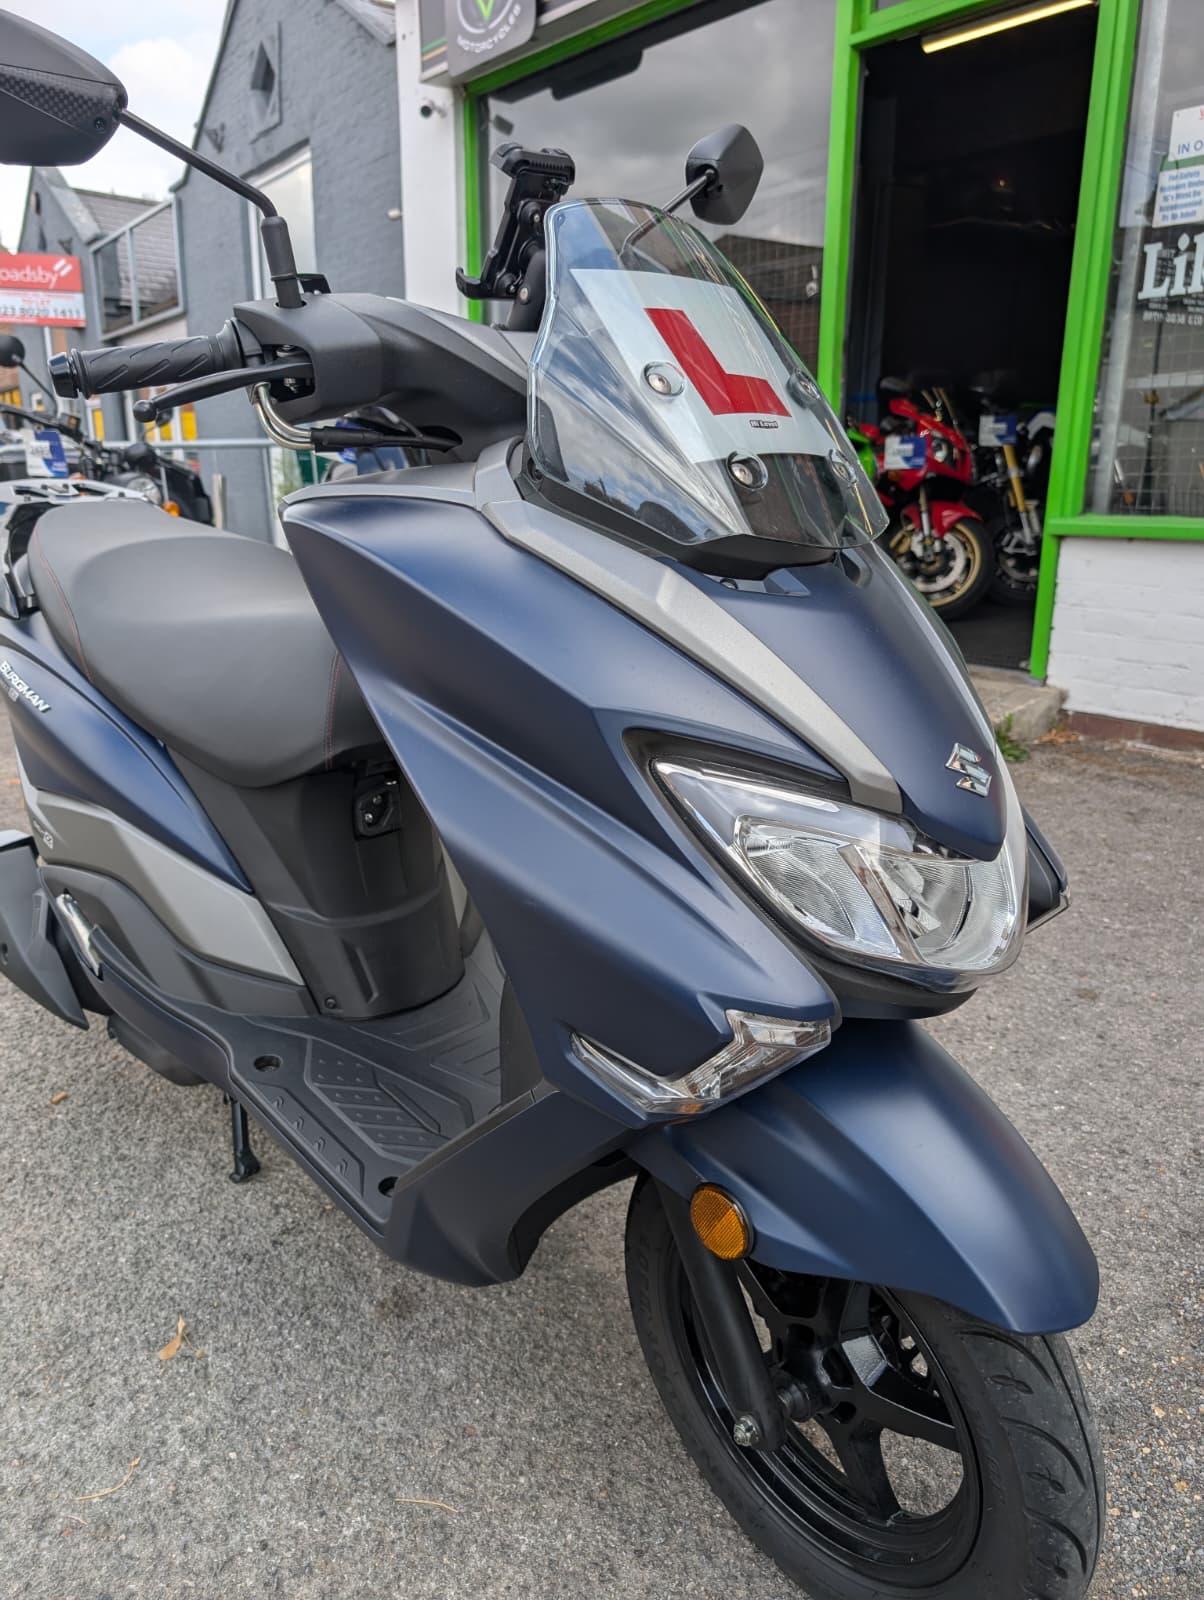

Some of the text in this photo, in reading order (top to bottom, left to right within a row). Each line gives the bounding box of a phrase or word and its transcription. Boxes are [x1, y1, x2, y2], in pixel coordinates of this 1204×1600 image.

[457, 3, 521, 53] MOTORCYCLES
[1177, 143, 1191, 154] IN
[643, 307, 792, 418] L
[0, 660, 50, 711] BURGMAN
